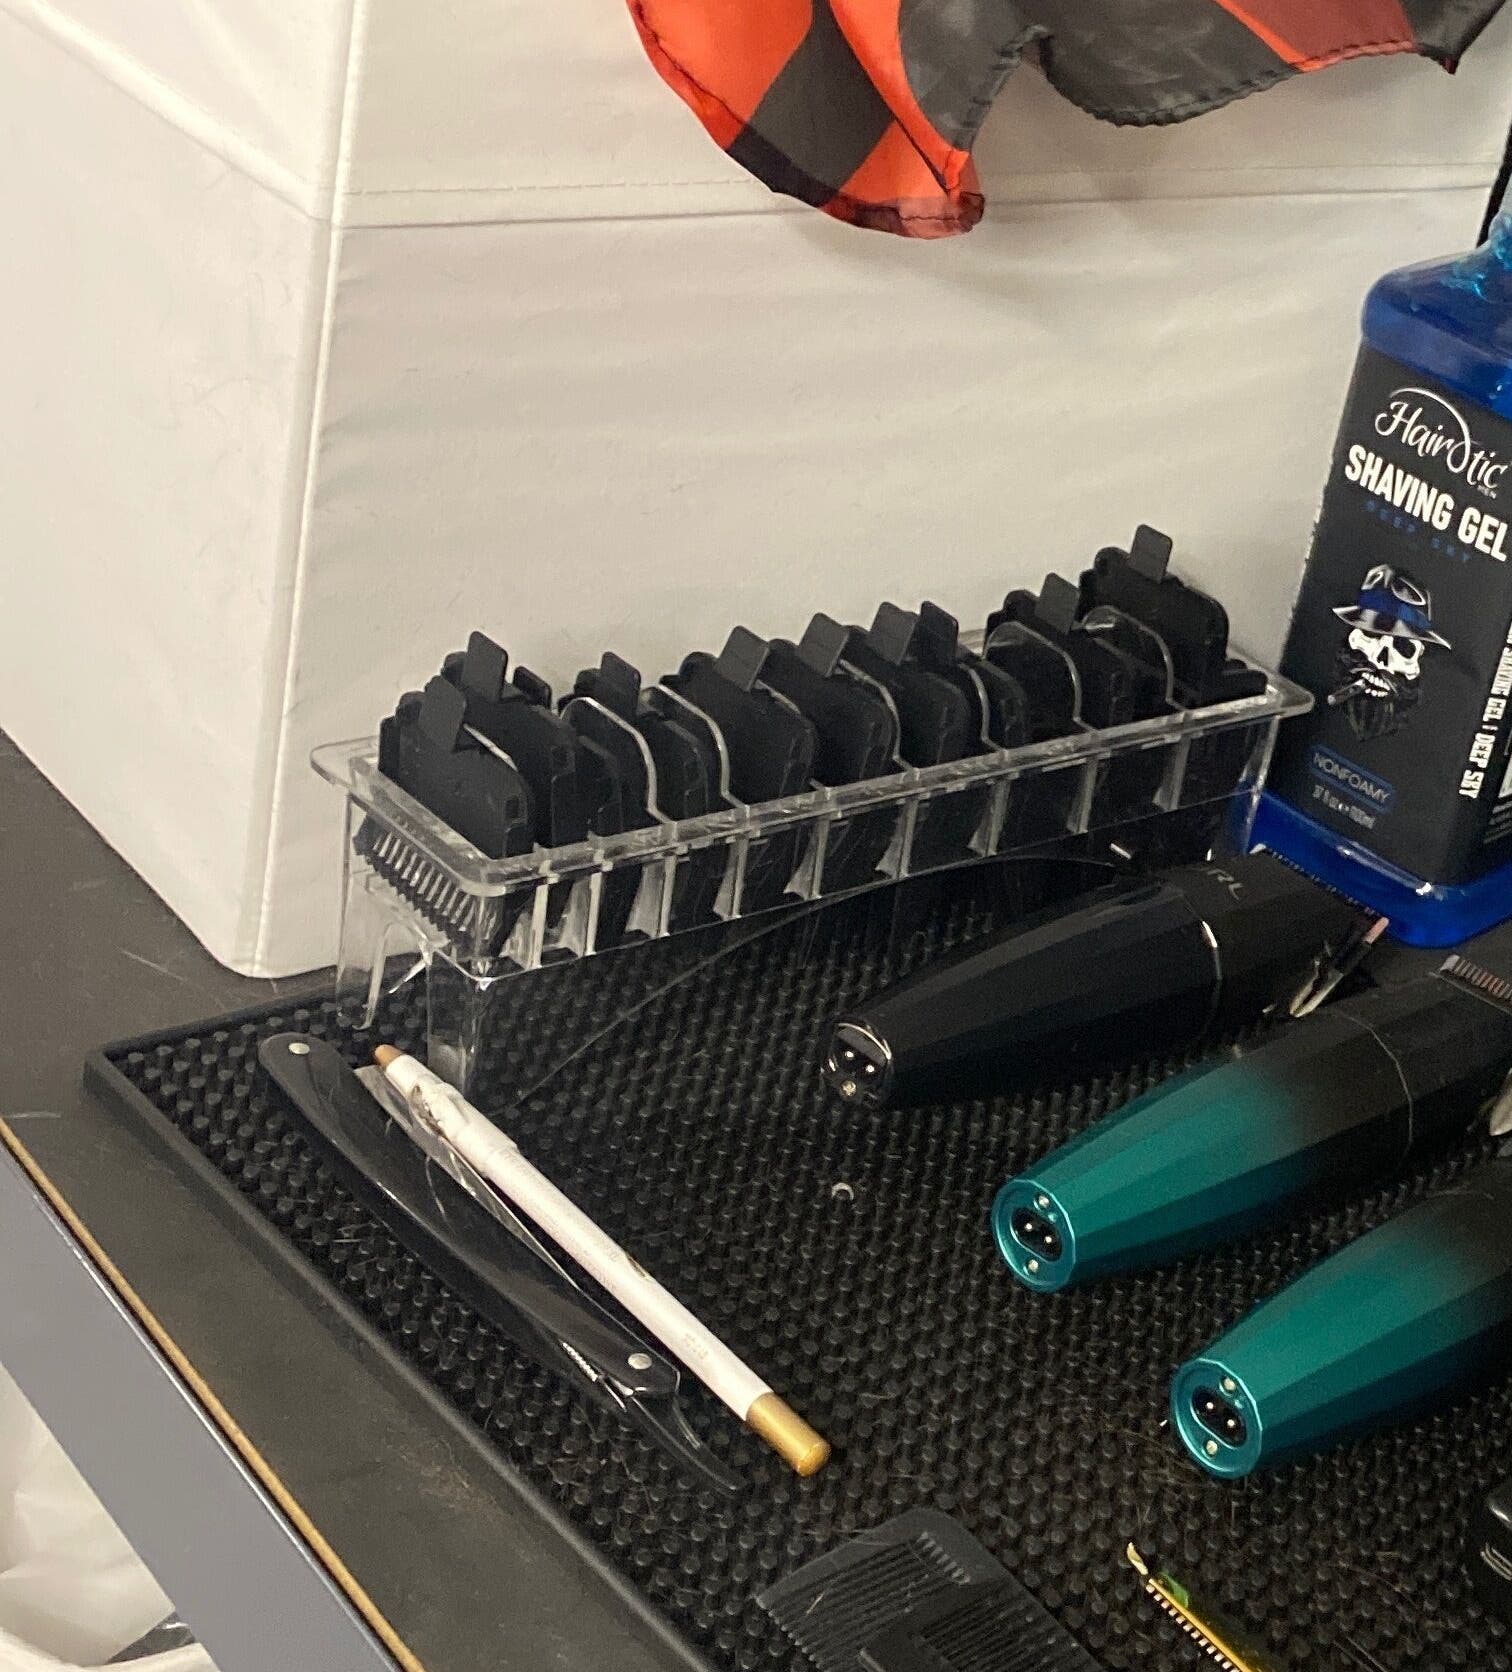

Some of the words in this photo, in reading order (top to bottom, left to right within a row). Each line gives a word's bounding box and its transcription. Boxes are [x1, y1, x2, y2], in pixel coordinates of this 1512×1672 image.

[1344, 444, 1455, 531] SHAVING
[1457, 506, 1509, 562] GEL
[1483, 697, 1507, 722] GEL
[1469, 733, 1496, 768] DEEP
[1313, 752, 1391, 803] NONFOAMY
[1458, 770, 1485, 799] SKY
